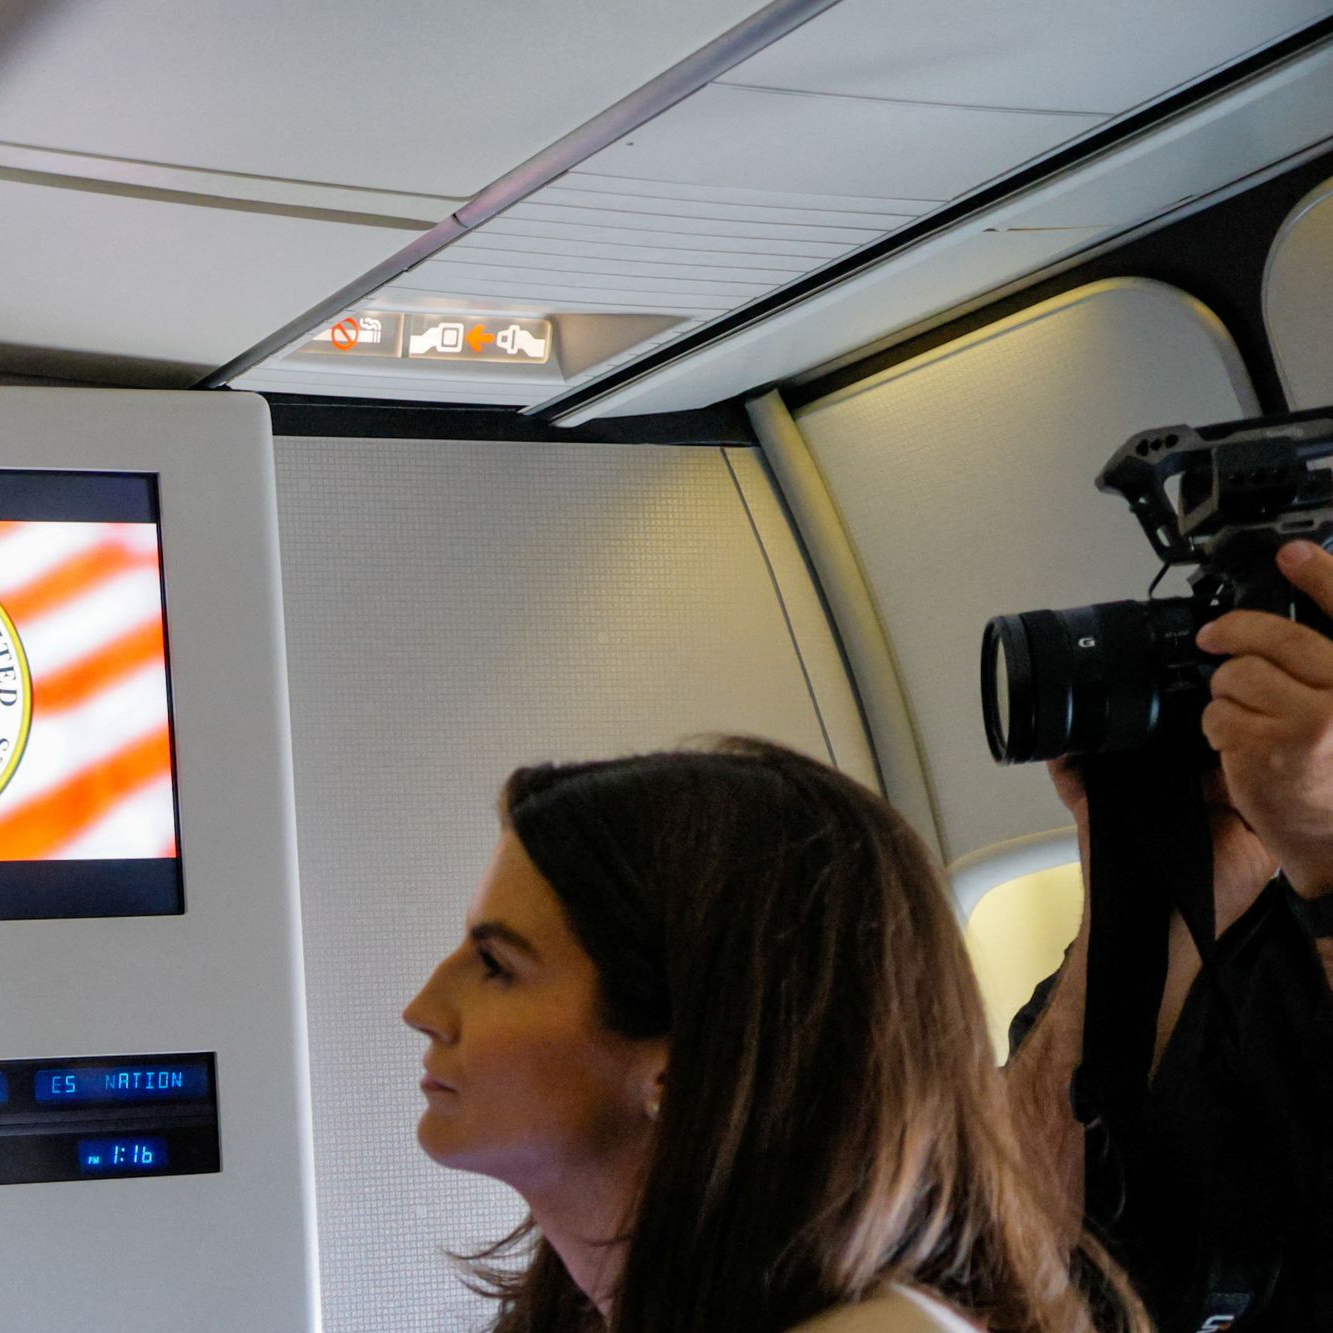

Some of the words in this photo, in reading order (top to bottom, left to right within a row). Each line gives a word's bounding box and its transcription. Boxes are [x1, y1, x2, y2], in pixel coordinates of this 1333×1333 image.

[1077, 637, 1096, 648] G
[51, 1075, 76, 1093] ES
[105, 1071, 183, 1089] NATION
[87, 1155, 100, 1165] PM
